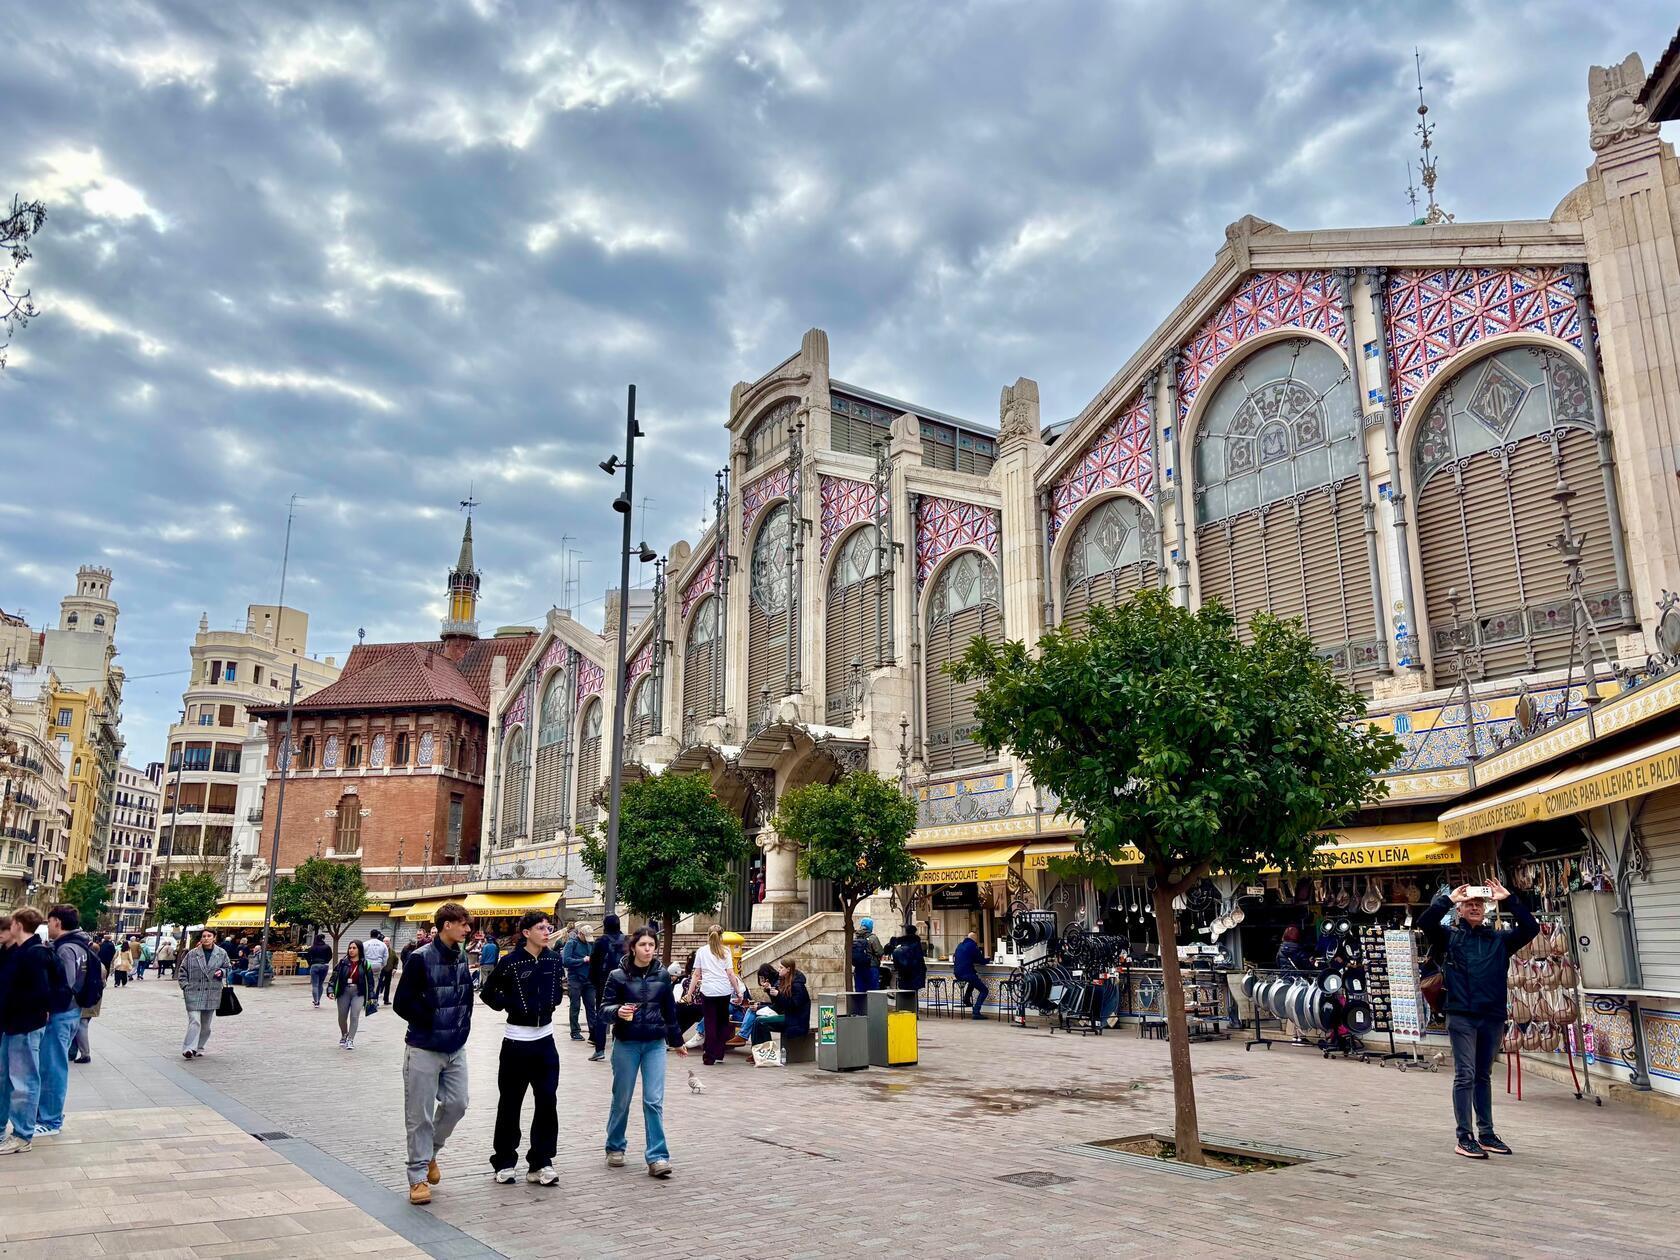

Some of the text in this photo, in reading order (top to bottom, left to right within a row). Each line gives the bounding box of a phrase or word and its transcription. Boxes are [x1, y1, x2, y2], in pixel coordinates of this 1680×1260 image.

[1545, 787, 1578, 814] COMIDAS
[1580, 781, 1601, 805] PARA
[1601, 770, 1634, 798] LLEVAR
[1636, 766, 1648, 789] EL
[1495, 807, 1504, 824] DE
[1504, 801, 1527, 822] REGALO
[1032, 856, 1045, 867] LAS
[1316, 852, 1364, 866] OS-GAS
[1367, 850, 1375, 863] Y
[1379, 846, 1410, 862] LEÑA
[919, 871, 940, 882] URROS
[941, 869, 978, 881] CHOCOLATE
